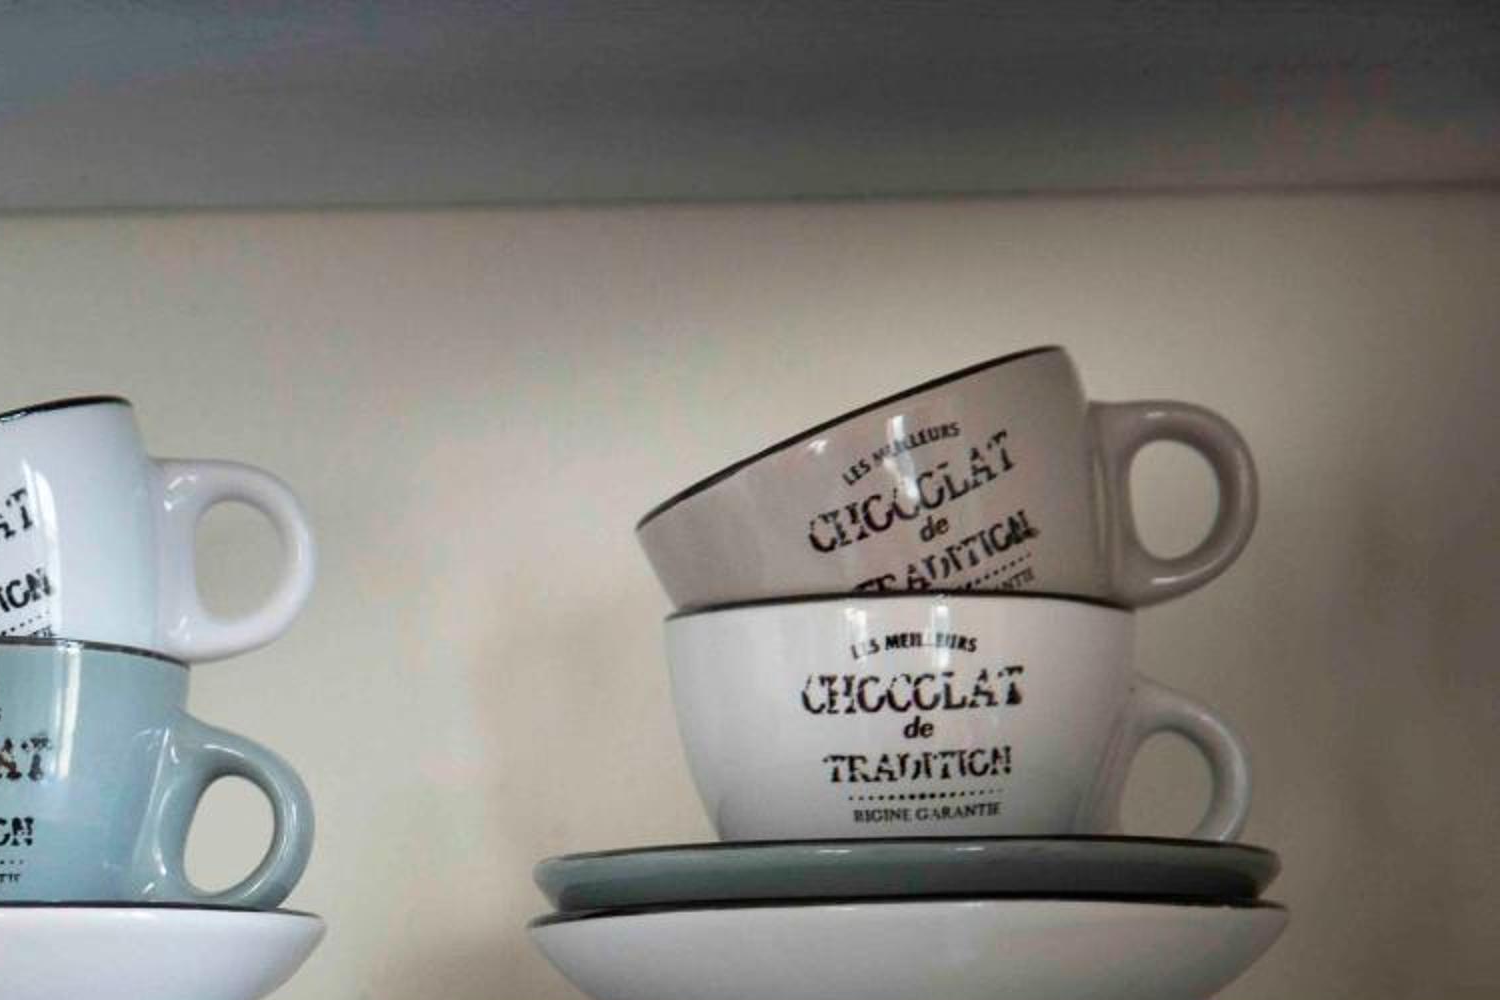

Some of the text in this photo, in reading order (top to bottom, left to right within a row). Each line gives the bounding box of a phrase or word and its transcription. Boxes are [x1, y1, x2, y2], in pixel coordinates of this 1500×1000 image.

[842, 459, 871, 486] LES
[809, 429, 1016, 553] CHOCOLAT
[918, 515, 949, 543] de
[850, 638, 880, 660] LS
[801, 665, 1025, 715] CHOCOLAT
[902, 715, 934, 739] de
[822, 746, 1012, 783] TRADITION
